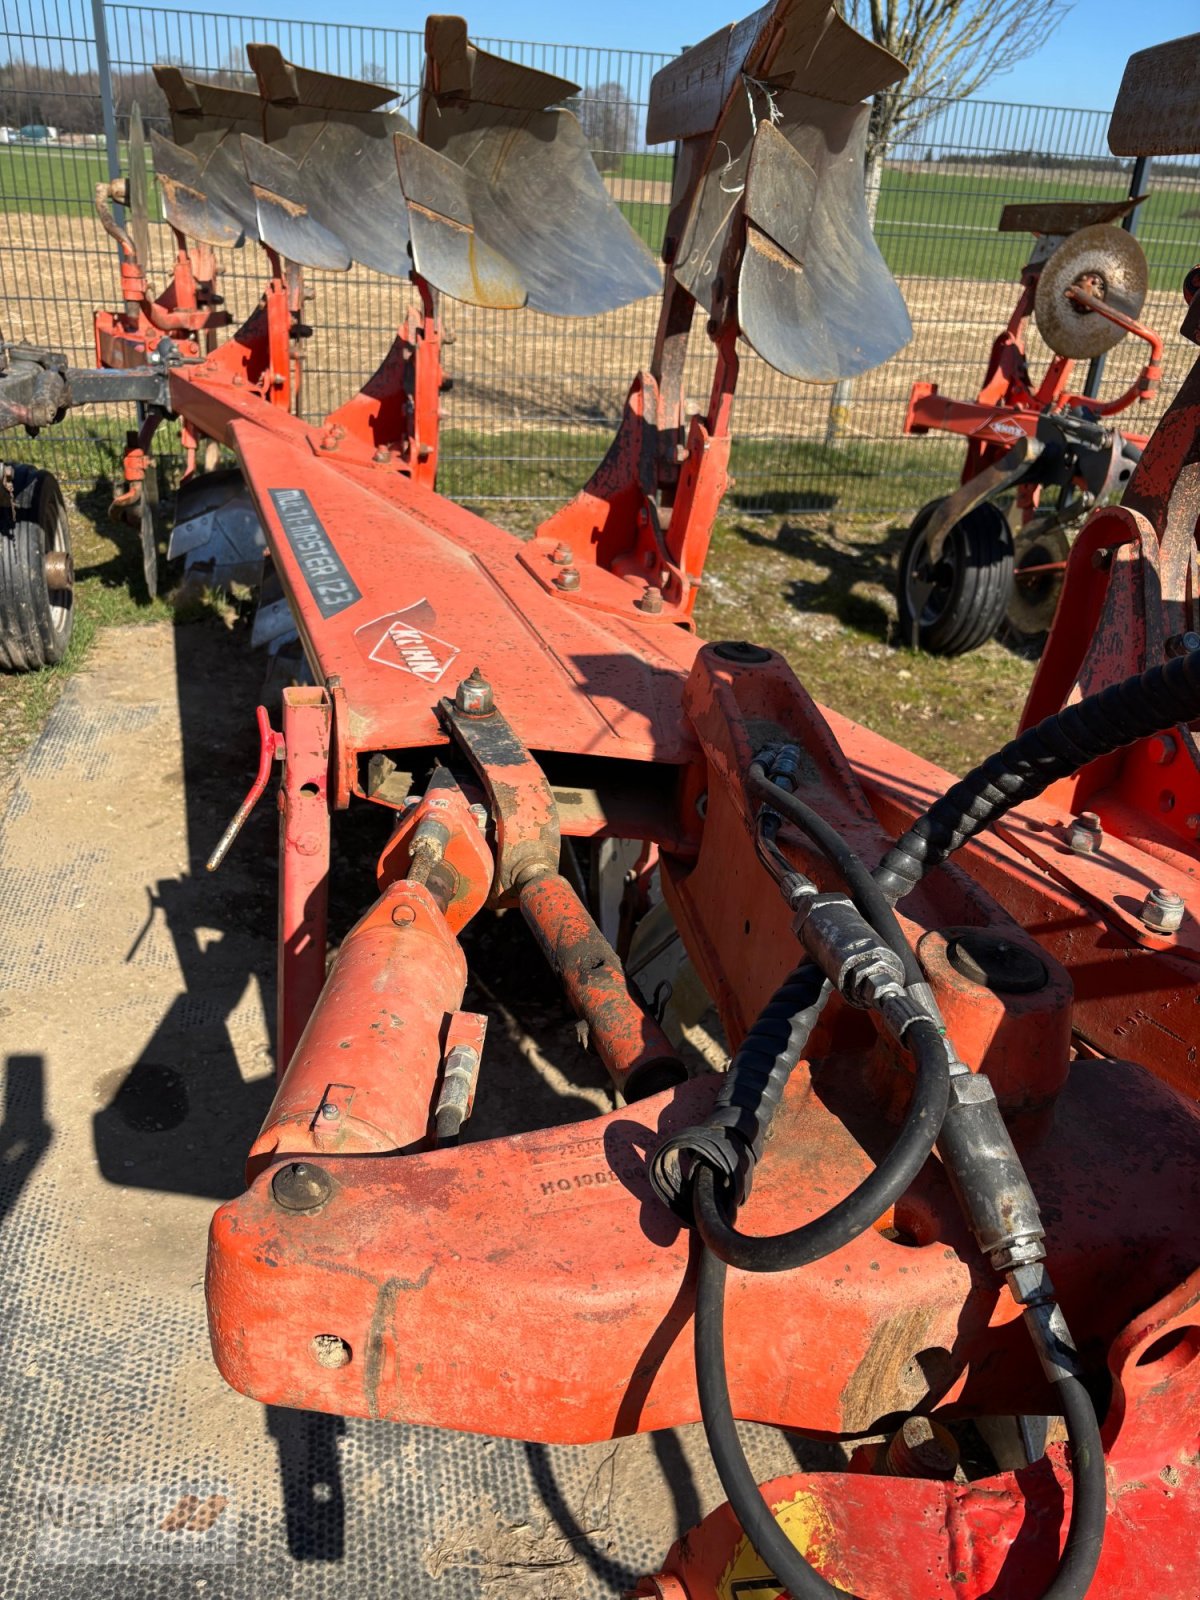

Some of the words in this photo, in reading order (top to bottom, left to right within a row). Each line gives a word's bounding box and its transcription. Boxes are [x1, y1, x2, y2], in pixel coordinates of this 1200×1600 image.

[275, 490, 339, 578] MULTI-MASTER
[316, 578, 354, 606] 123
[389, 629, 444, 673] KUHN
